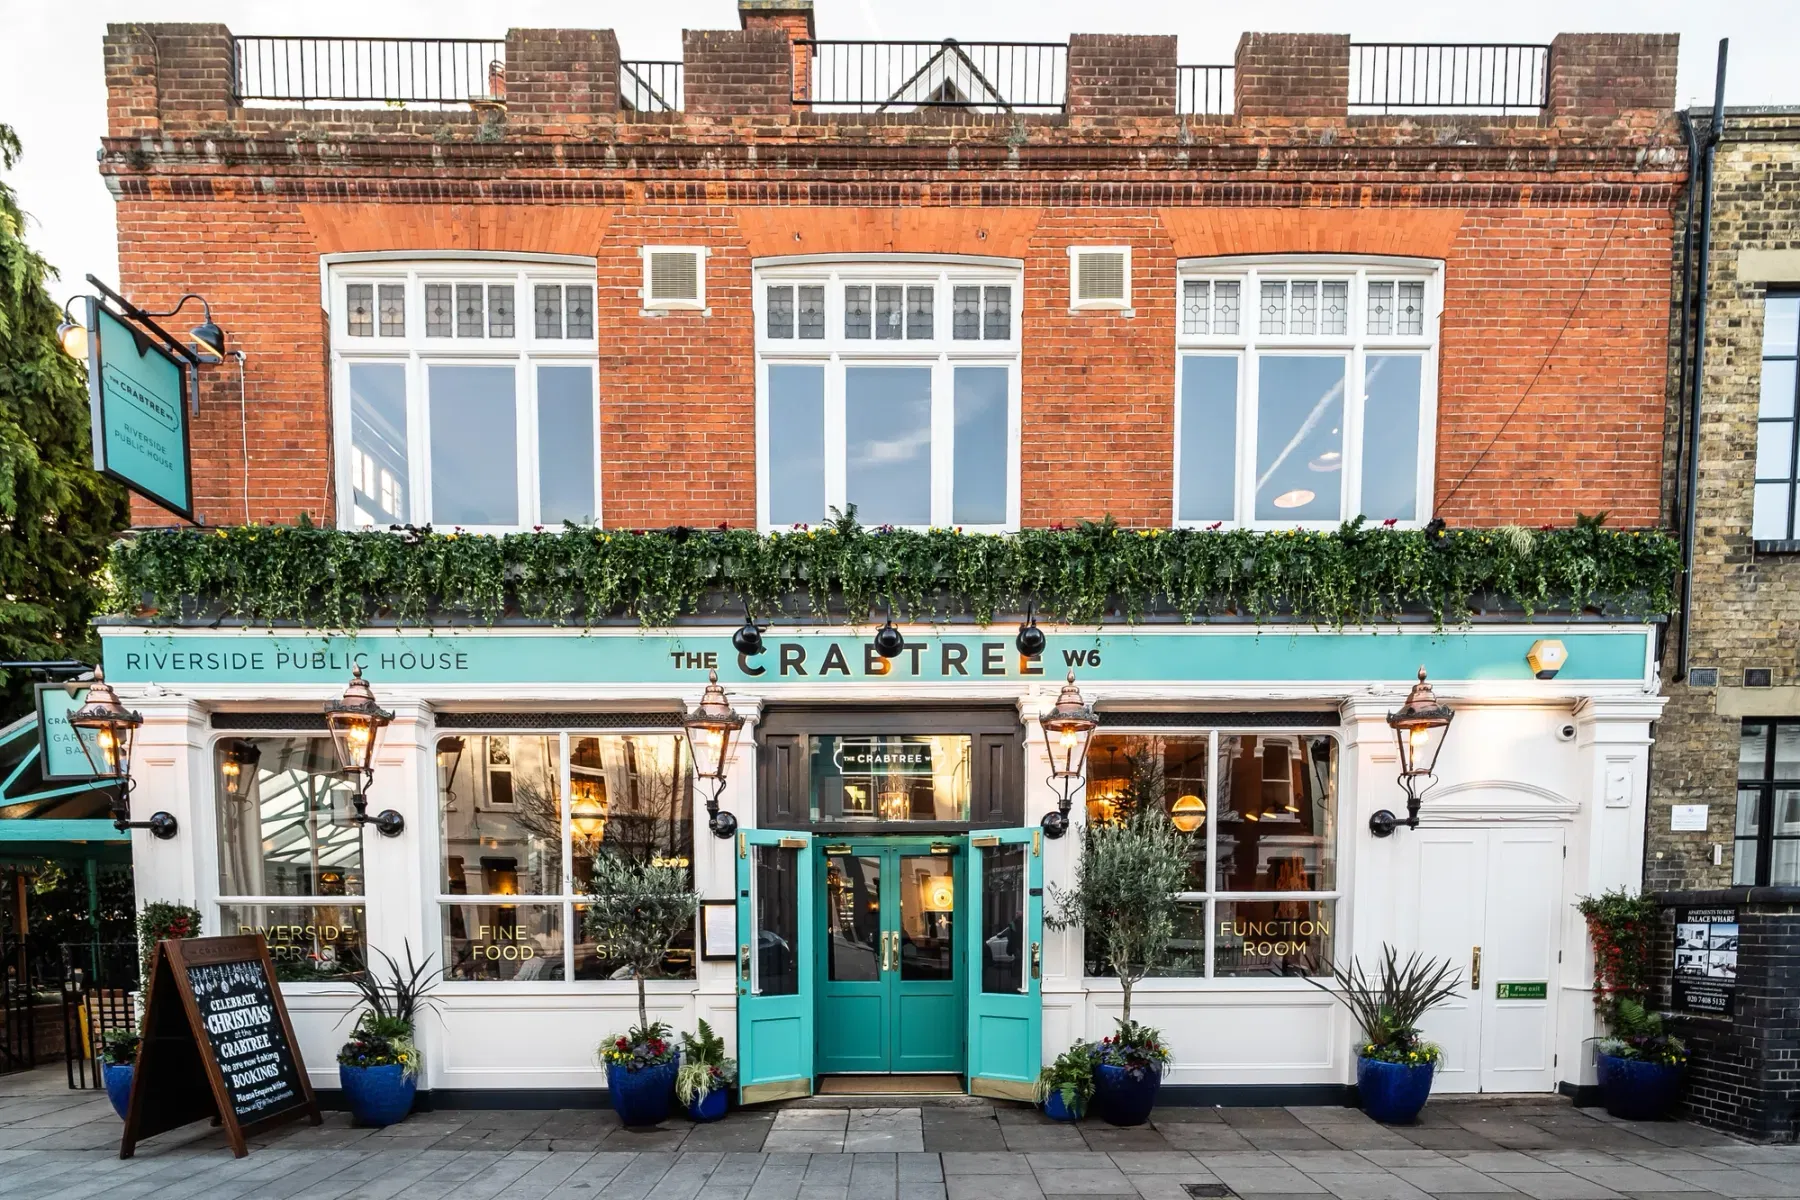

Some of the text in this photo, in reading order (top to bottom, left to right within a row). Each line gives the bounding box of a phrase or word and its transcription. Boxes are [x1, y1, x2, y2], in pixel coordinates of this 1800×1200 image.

[120, 382, 166, 417] CRABTREE
[124, 423, 166, 455] RIVERSIDE
[114, 430, 174, 471] PUBLIC HOUSE
[126, 653, 469, 670] RIVERSIDE PUBLIC HOUSE
[670, 643, 1103, 676] THE CRABTREE W6
[53, 733, 95, 743] GARDE
[857, 754, 922, 763] CRABTREE
[1711, 915, 1736, 923] WHARF
[479, 925, 528, 940] FINE
[1220, 921, 1330, 936] FUNCTION
[473, 945, 535, 961] FOOD
[1243, 941, 1307, 956] ROOM
[210, 993, 258, 1011] CELEBRATE
[1687, 995, 1698, 1003] 020
[208, 1005, 271, 1034] CHRISTMAS
[221, 1033, 272, 1058] CRABTREE
[220, 1052, 280, 1073] We are now taking
[231, 1063, 279, 1088] BOOKINGS
